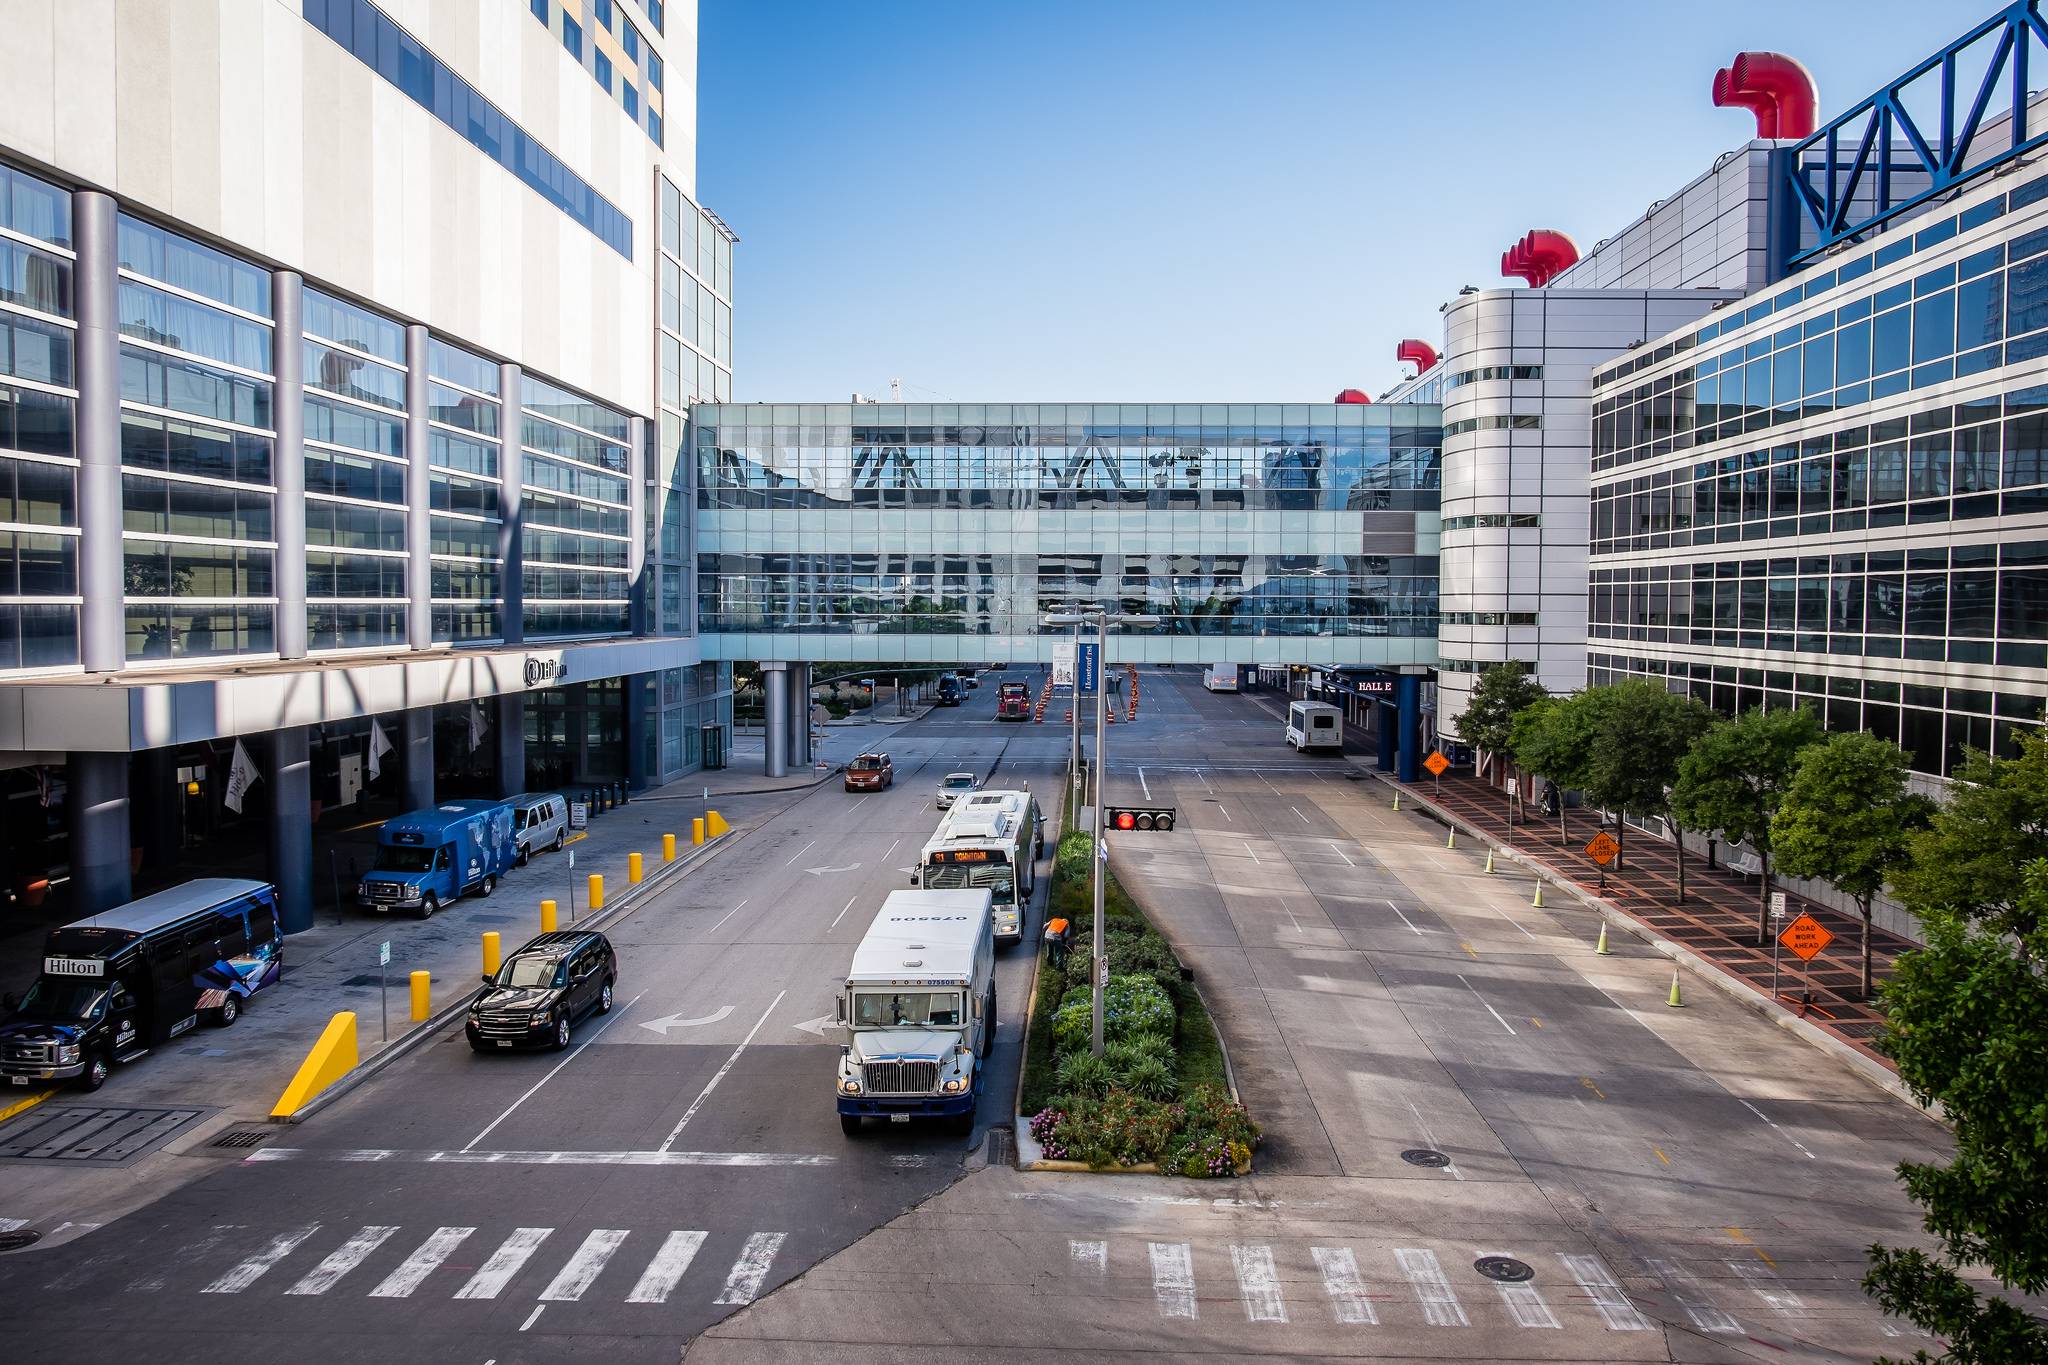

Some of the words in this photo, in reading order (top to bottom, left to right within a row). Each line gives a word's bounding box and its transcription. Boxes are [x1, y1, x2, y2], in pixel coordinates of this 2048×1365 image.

[541, 659, 568, 680] Hilton
[1359, 682, 1382, 690] HALL
[1385, 682, 1391, 690] E
[954, 852, 986, 862] DOWNTOWN
[50, 959, 97, 974] Hilton
[116, 1029, 135, 1043] Hilton
